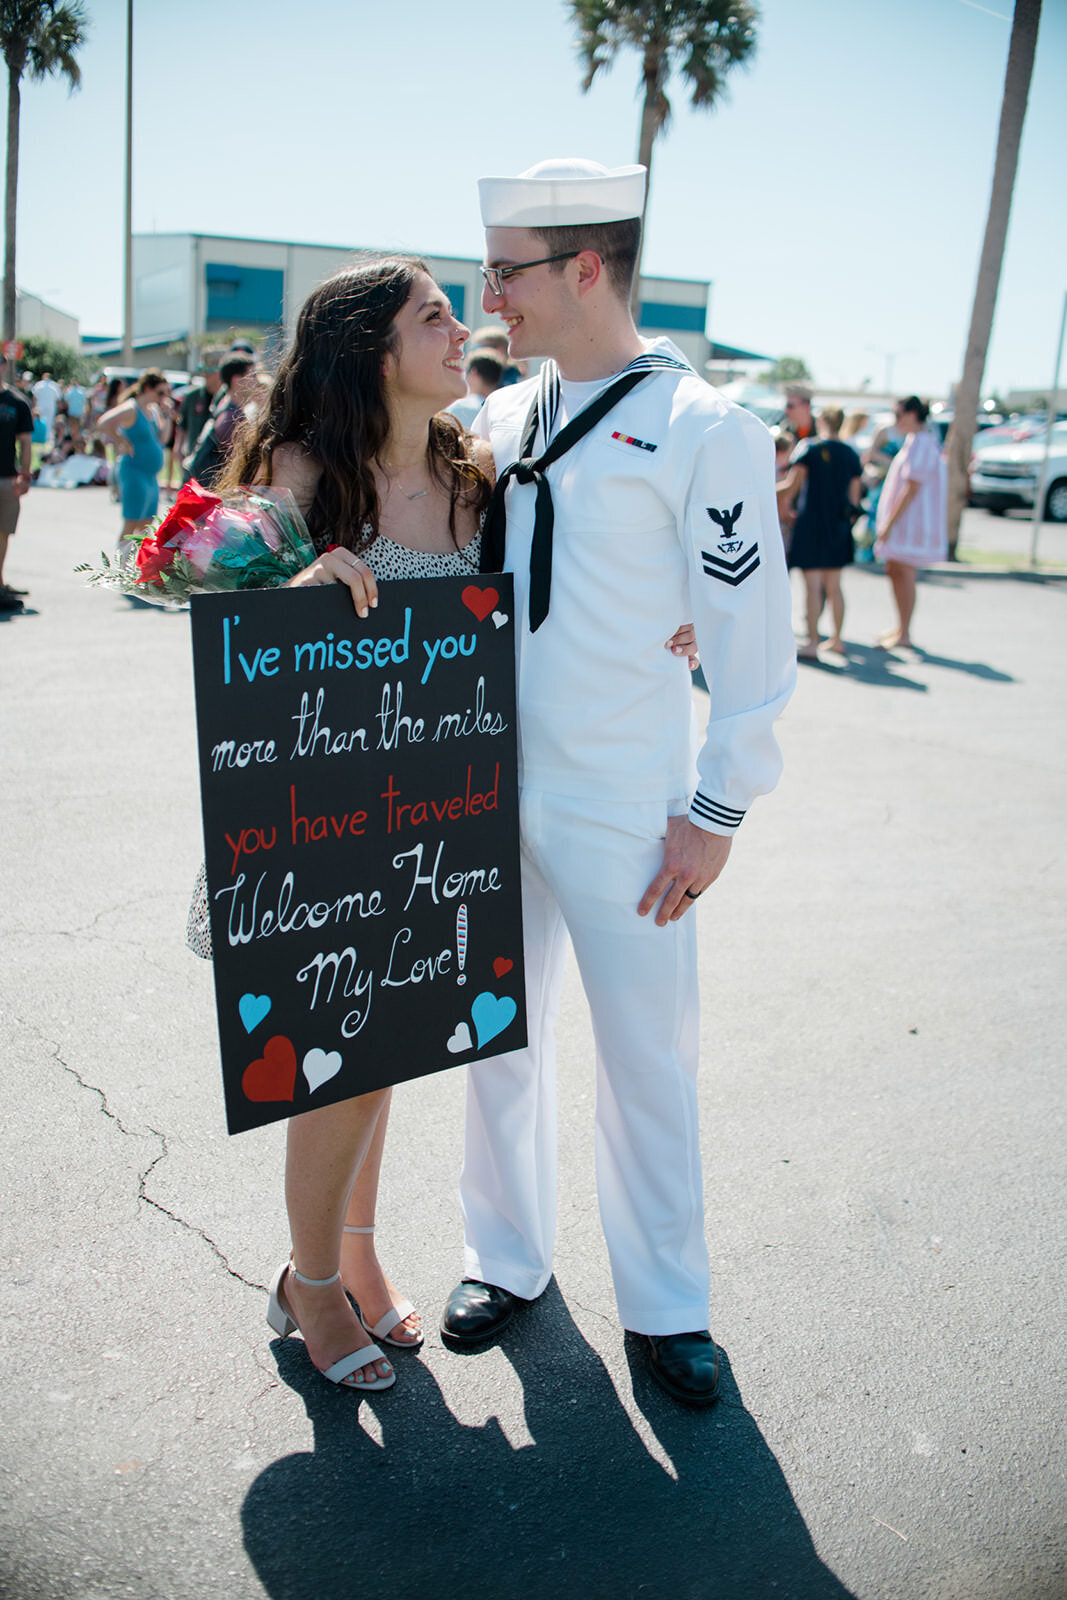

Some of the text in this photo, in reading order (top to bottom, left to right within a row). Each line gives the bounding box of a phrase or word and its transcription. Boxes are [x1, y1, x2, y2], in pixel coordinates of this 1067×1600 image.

[223, 607, 477, 684] I've missed you
[211, 675, 508, 772] more than the miles
[225, 762, 500, 875] you have traveled
[214, 840, 502, 946] Welcome Home
[296, 903, 468, 1038] My Love!
